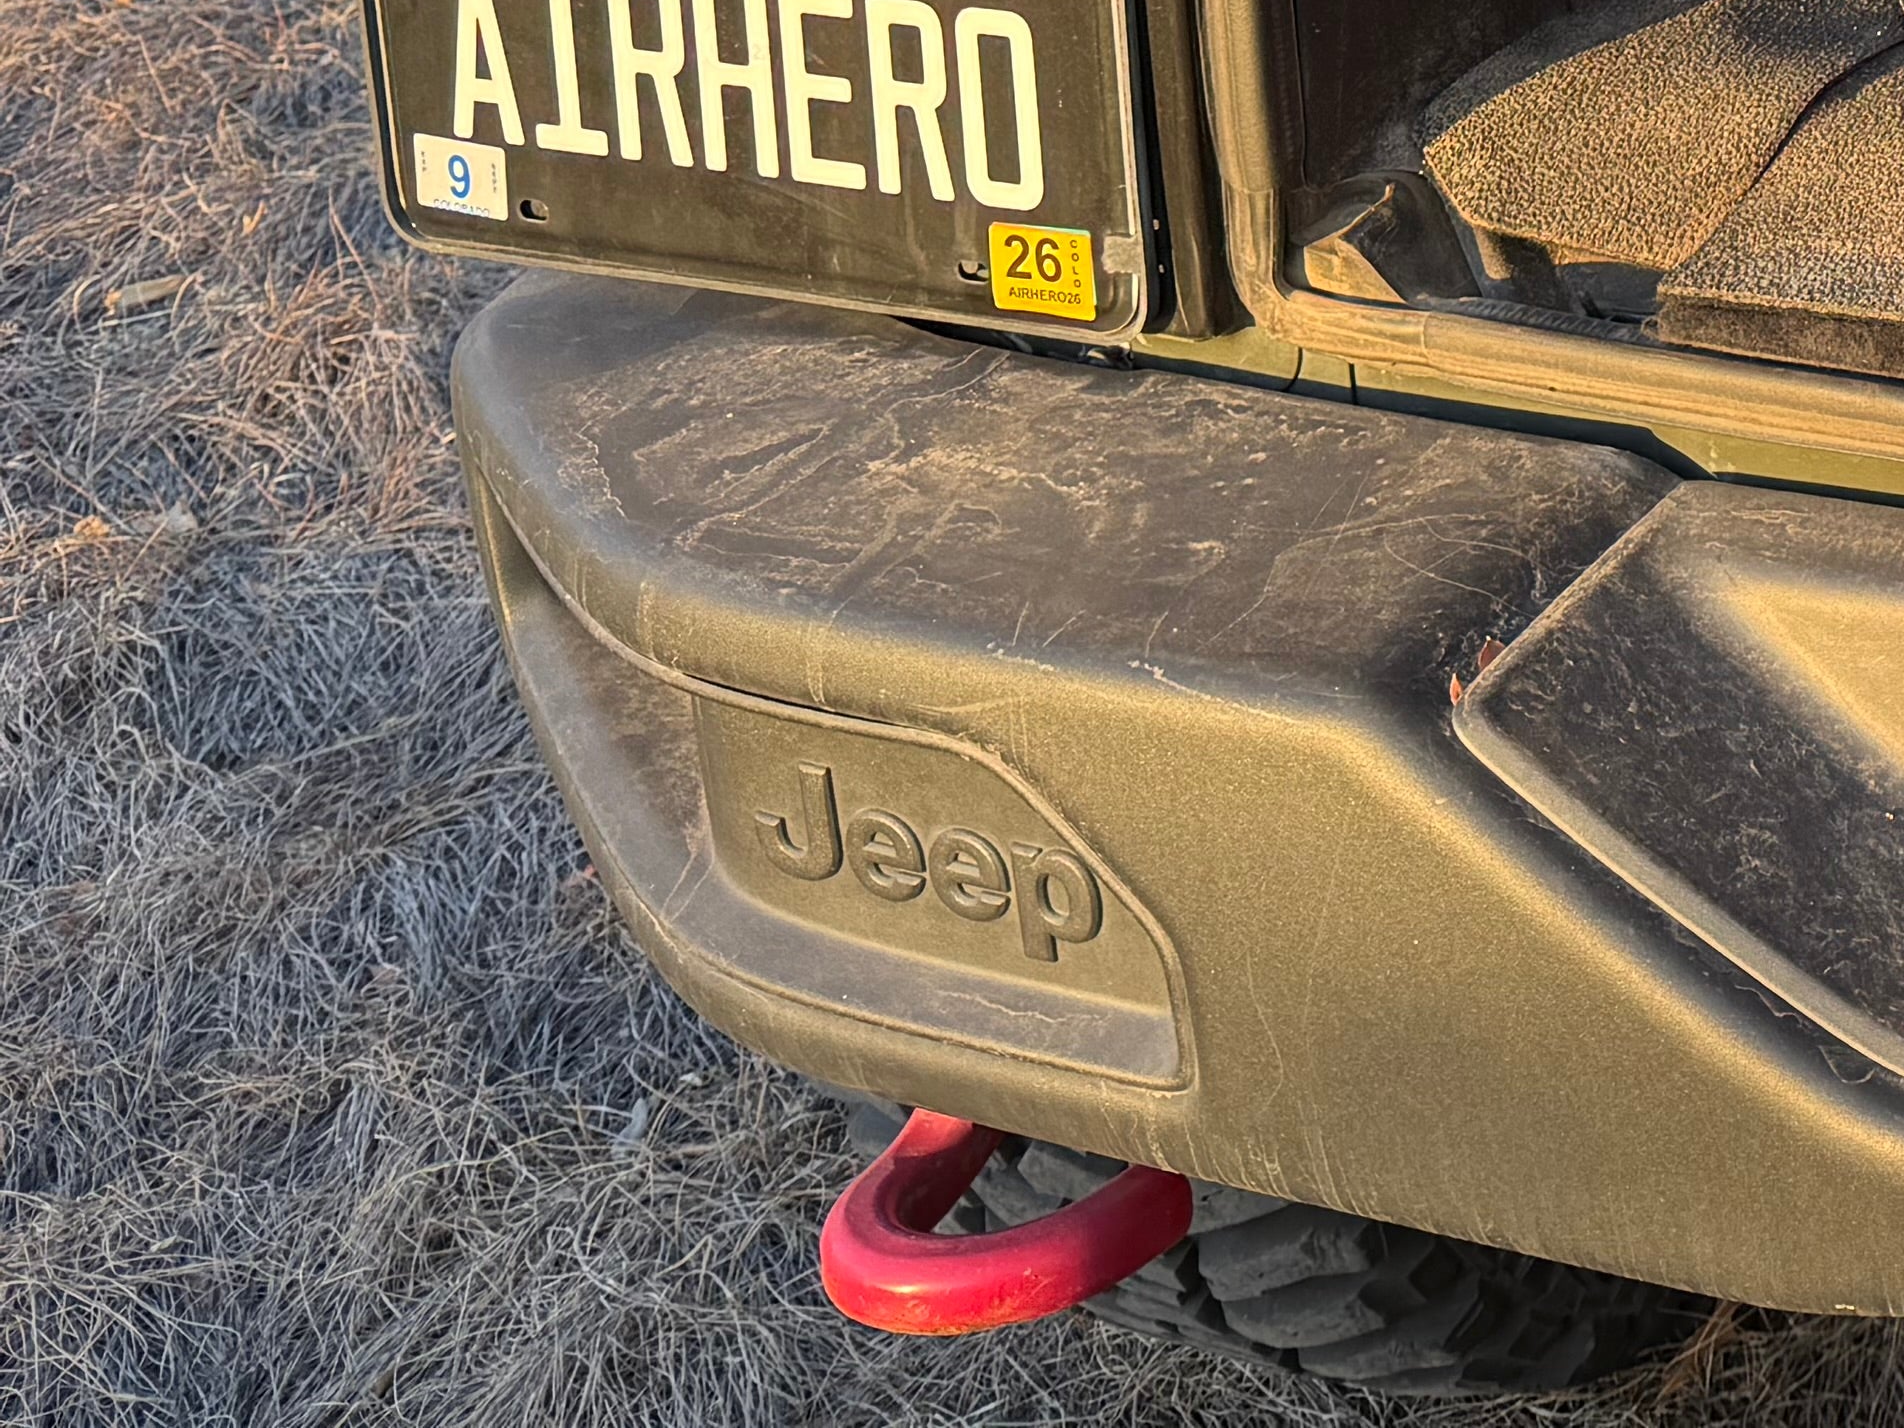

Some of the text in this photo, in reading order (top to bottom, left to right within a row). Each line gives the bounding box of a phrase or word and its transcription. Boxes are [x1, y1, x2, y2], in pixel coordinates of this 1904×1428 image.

[448, 154, 471, 199] 9
[1004, 234, 1063, 283] 26
[1008, 286, 1082, 305] AIRHERO26
[754, 758, 1104, 963] Jeep
